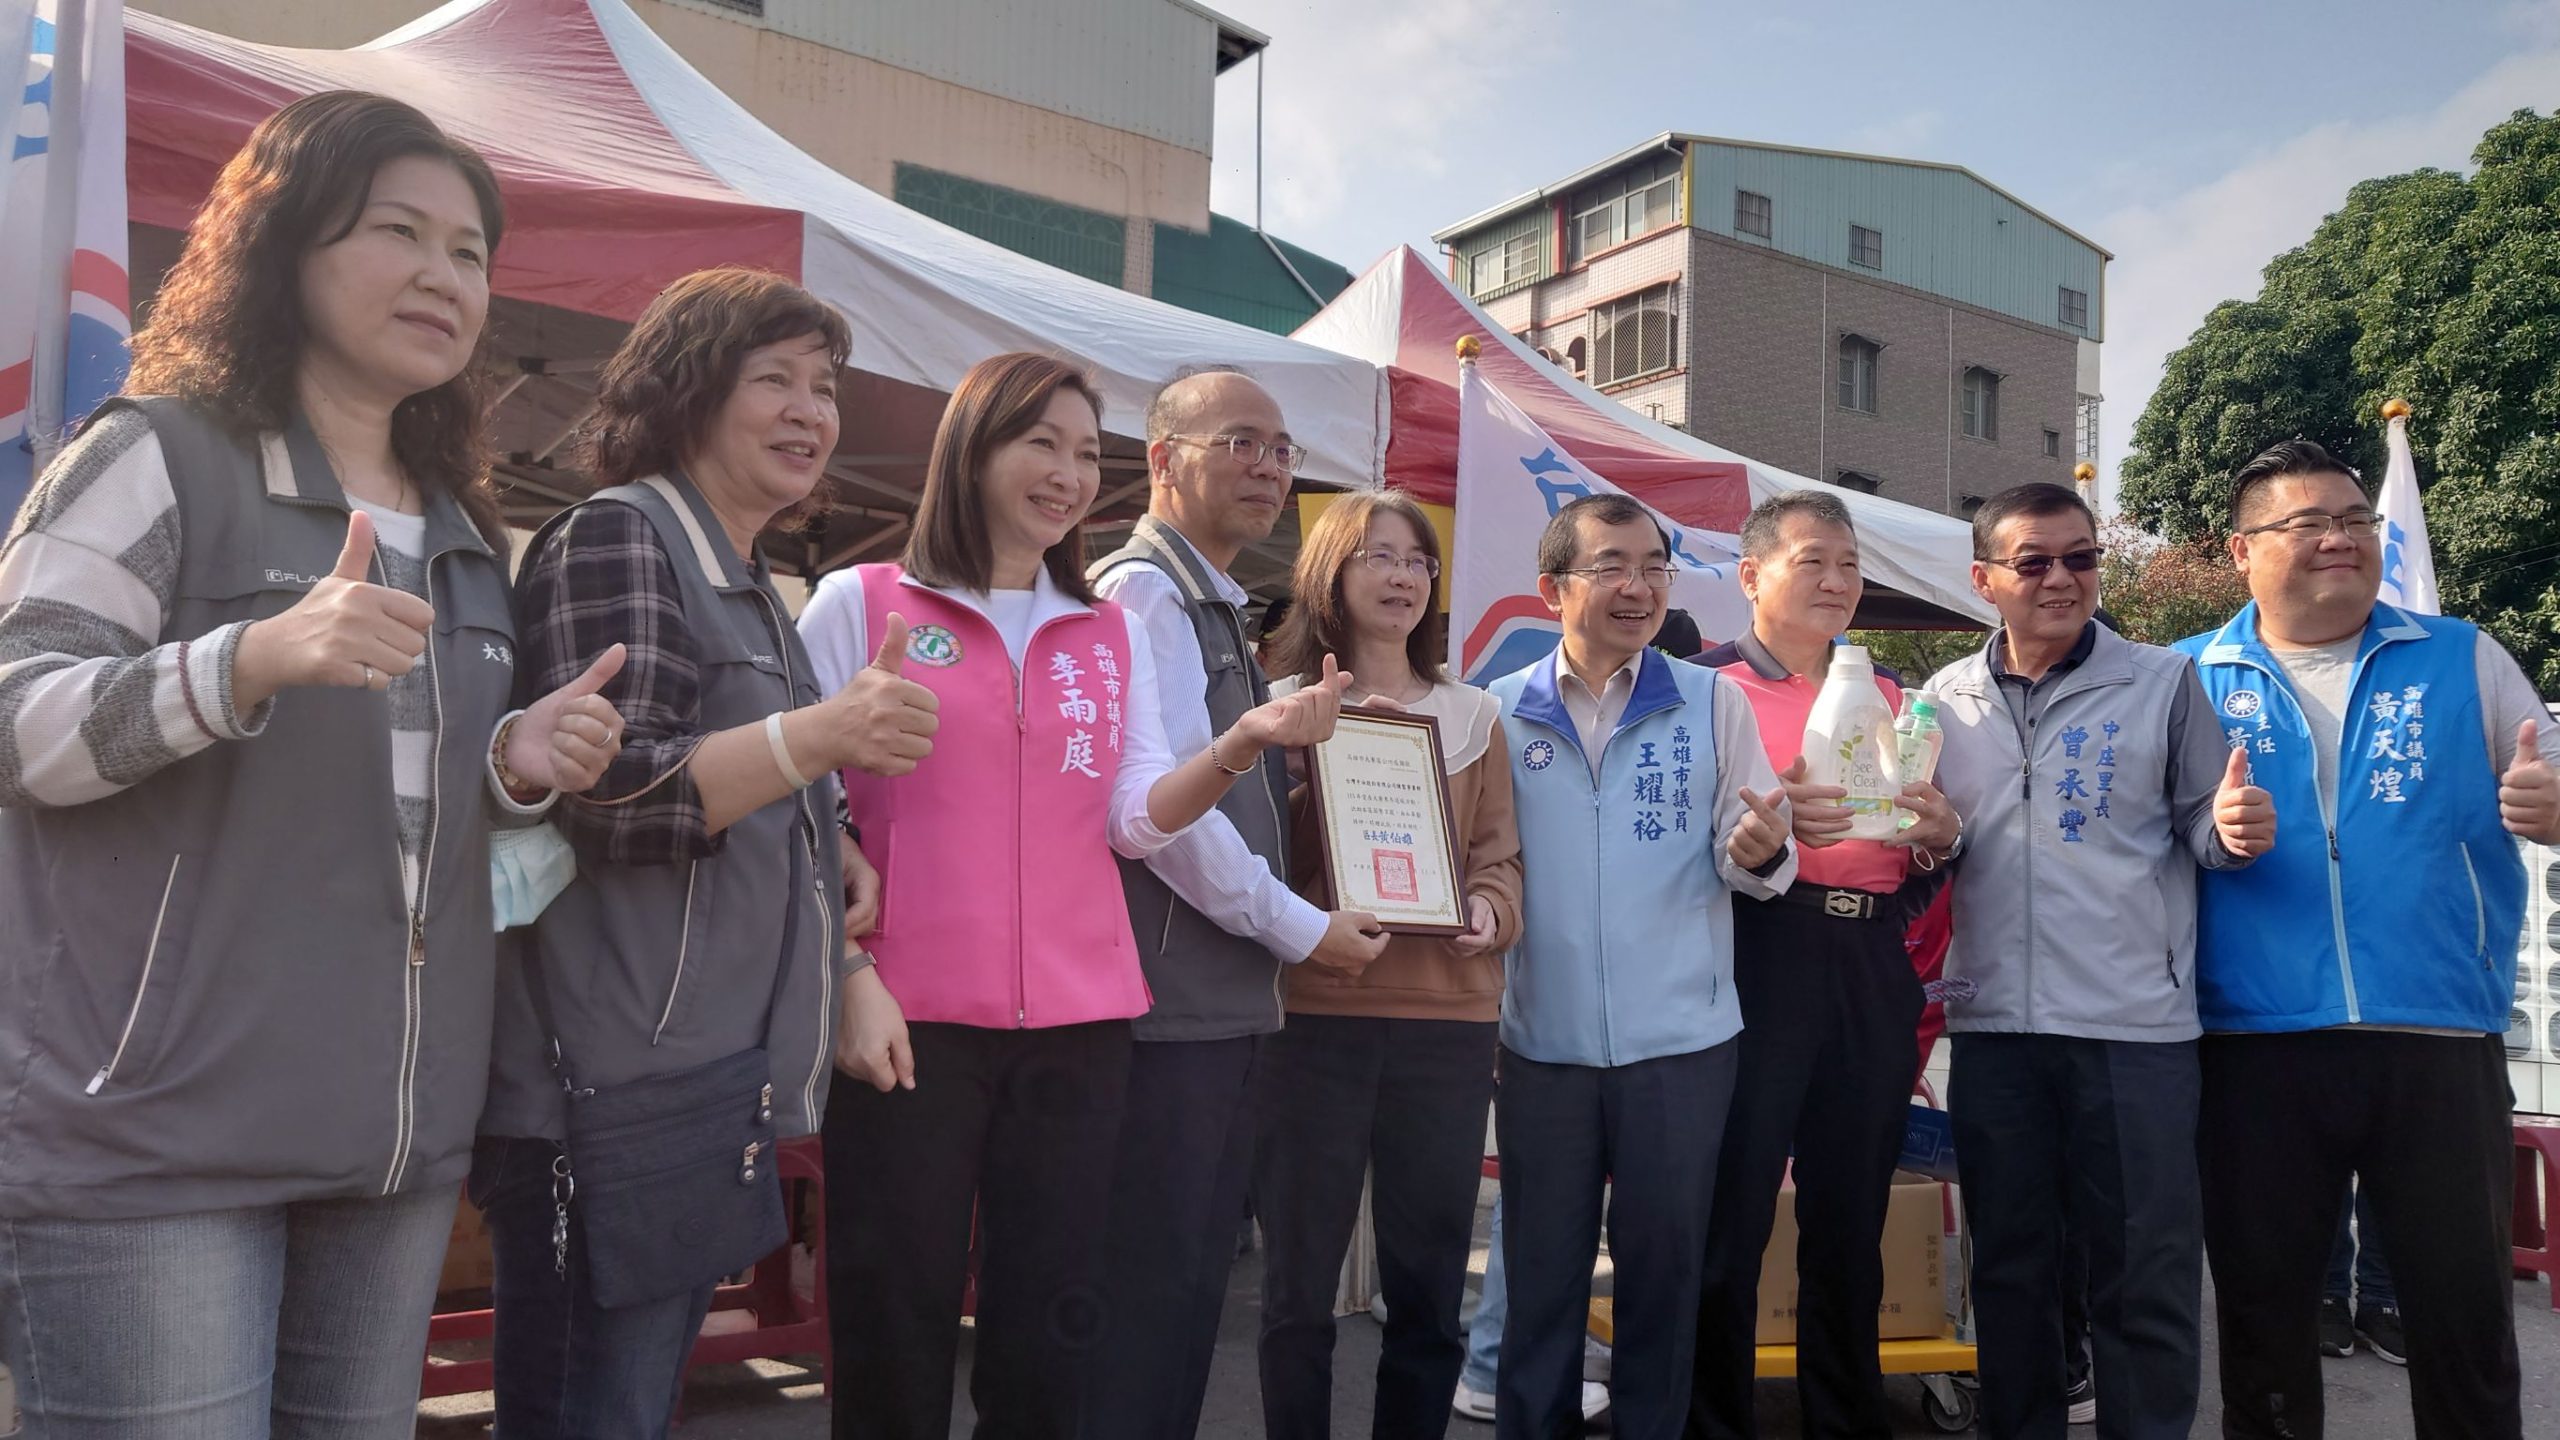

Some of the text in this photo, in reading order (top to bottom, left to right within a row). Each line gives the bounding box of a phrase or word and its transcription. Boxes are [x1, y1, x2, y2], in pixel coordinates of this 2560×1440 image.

[1049, 651, 1102, 778] 李雨庭
[1092, 643, 1122, 753] 高雄市議員
[2256, 712, 2277, 755] 主任
[2369, 691, 2407, 803] 黃天煌
[2403, 685, 2427, 781] 高雄市議員
[1633, 742, 1668, 842] 王耀裕
[1672, 725, 1693, 833] 高雄市議員
[2094, 720, 2120, 819] 中庄里長
